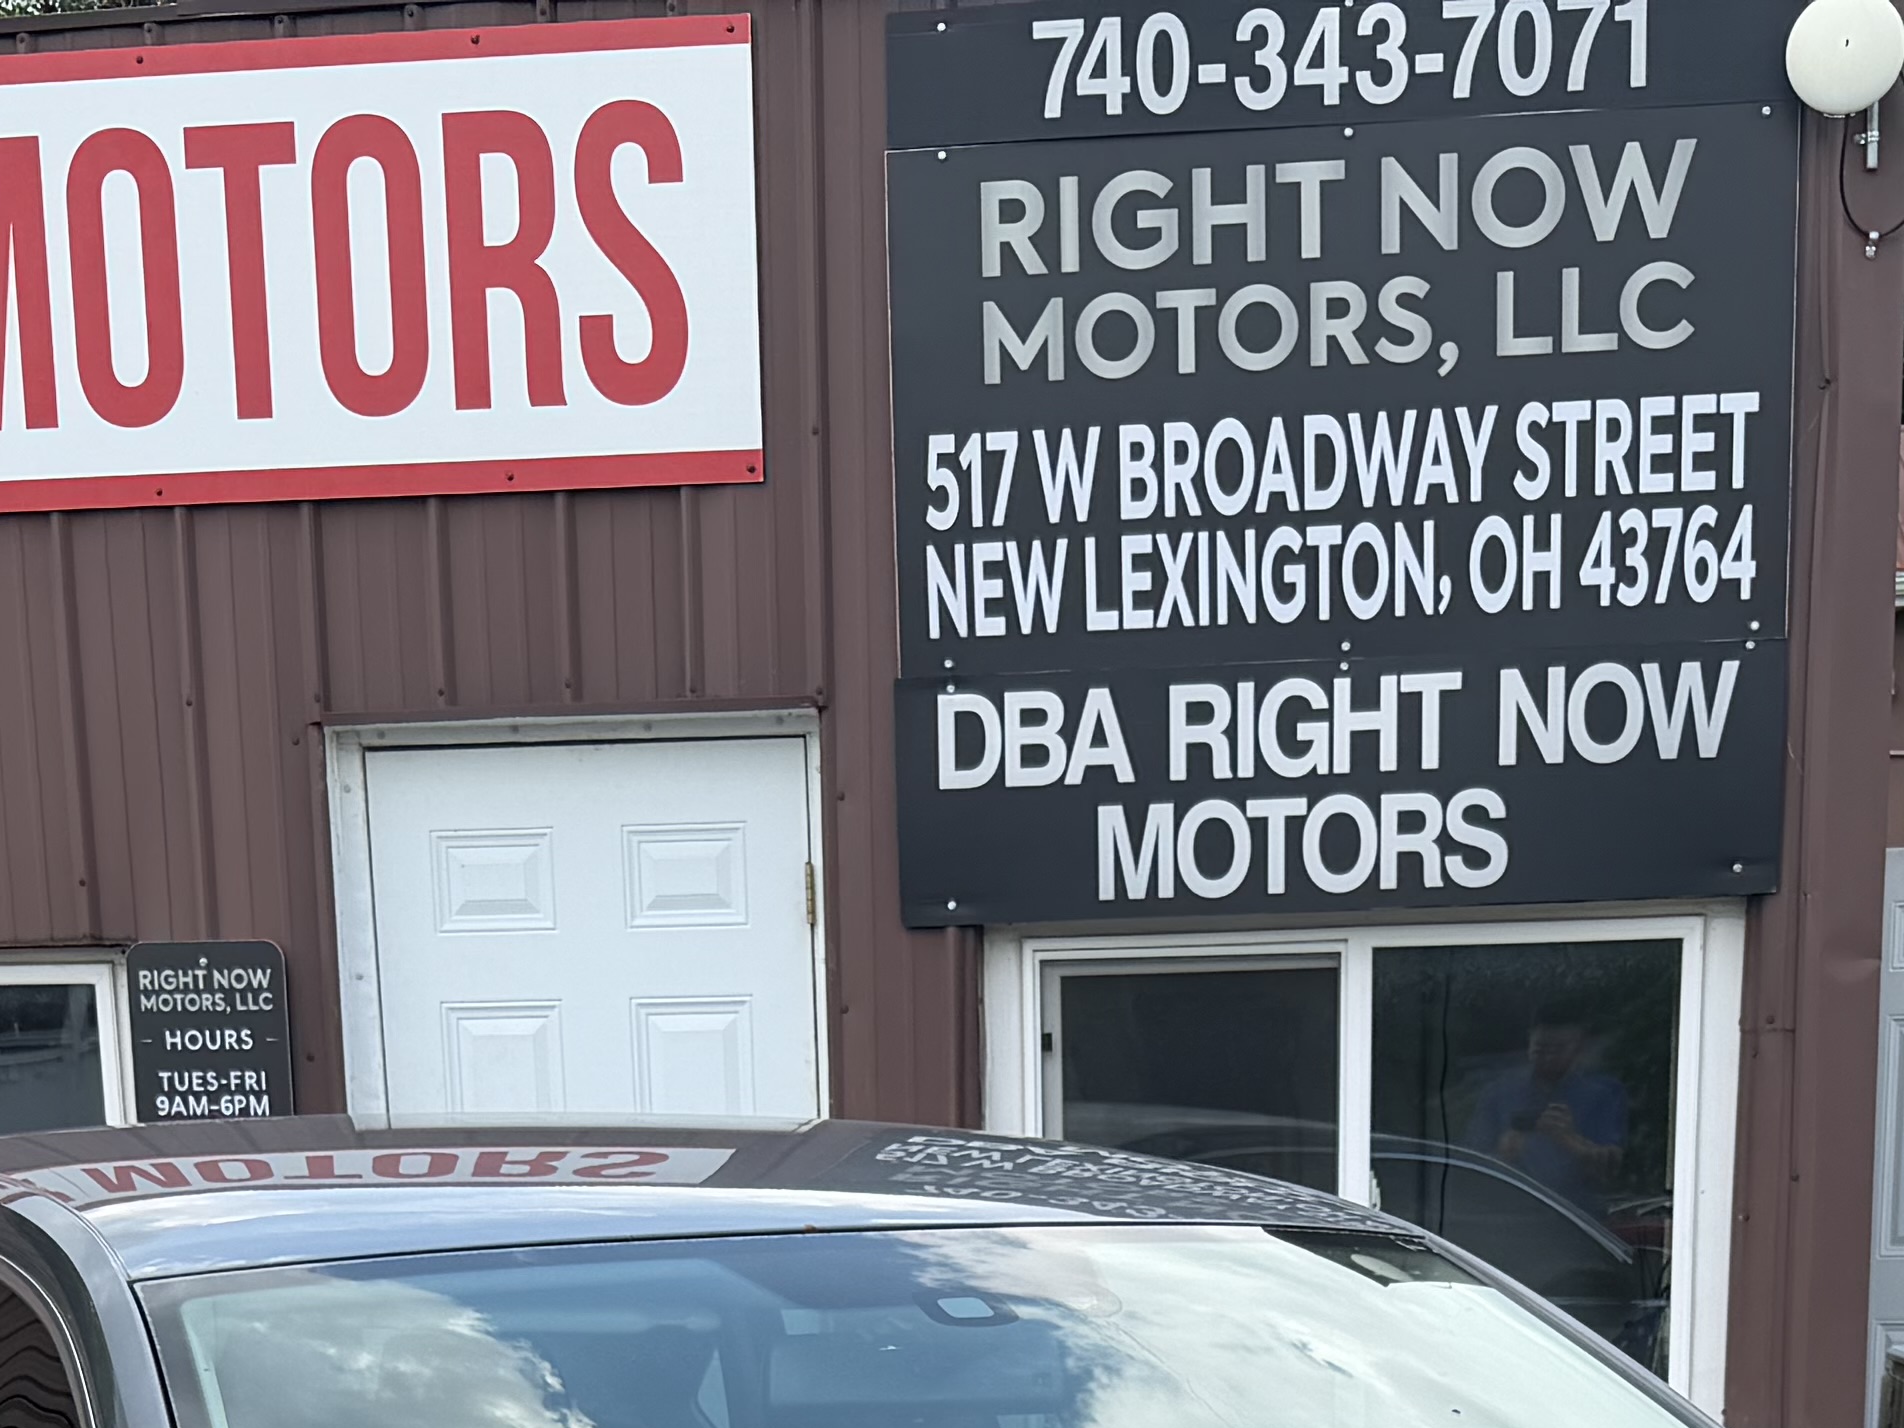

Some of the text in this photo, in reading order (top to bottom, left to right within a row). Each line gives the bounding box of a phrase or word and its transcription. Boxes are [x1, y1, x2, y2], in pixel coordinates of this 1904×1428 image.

[1032, 0, 1649, 119] 740-343-7071
[980, 137, 1698, 278] RIGHT NOW
[982, 260, 1696, 384] MOTORS, LLC
[926, 392, 1760, 530] 517 W BROADWAY STREET
[926, 504, 1756, 638] NEW LEXINGTON, OH 43764
[937, 660, 1740, 790] DBA RIGHT NOW
[1097, 787, 1509, 901] MOTORS
[138, 968, 272, 991] RIGHT NOW
[140, 992, 274, 1014] MOTORS, LLC
[158, 1070, 267, 1092] TUES-FRI
[165, 1029, 254, 1051] HOURS
[156, 1095, 270, 1117] 9AM-6PM
